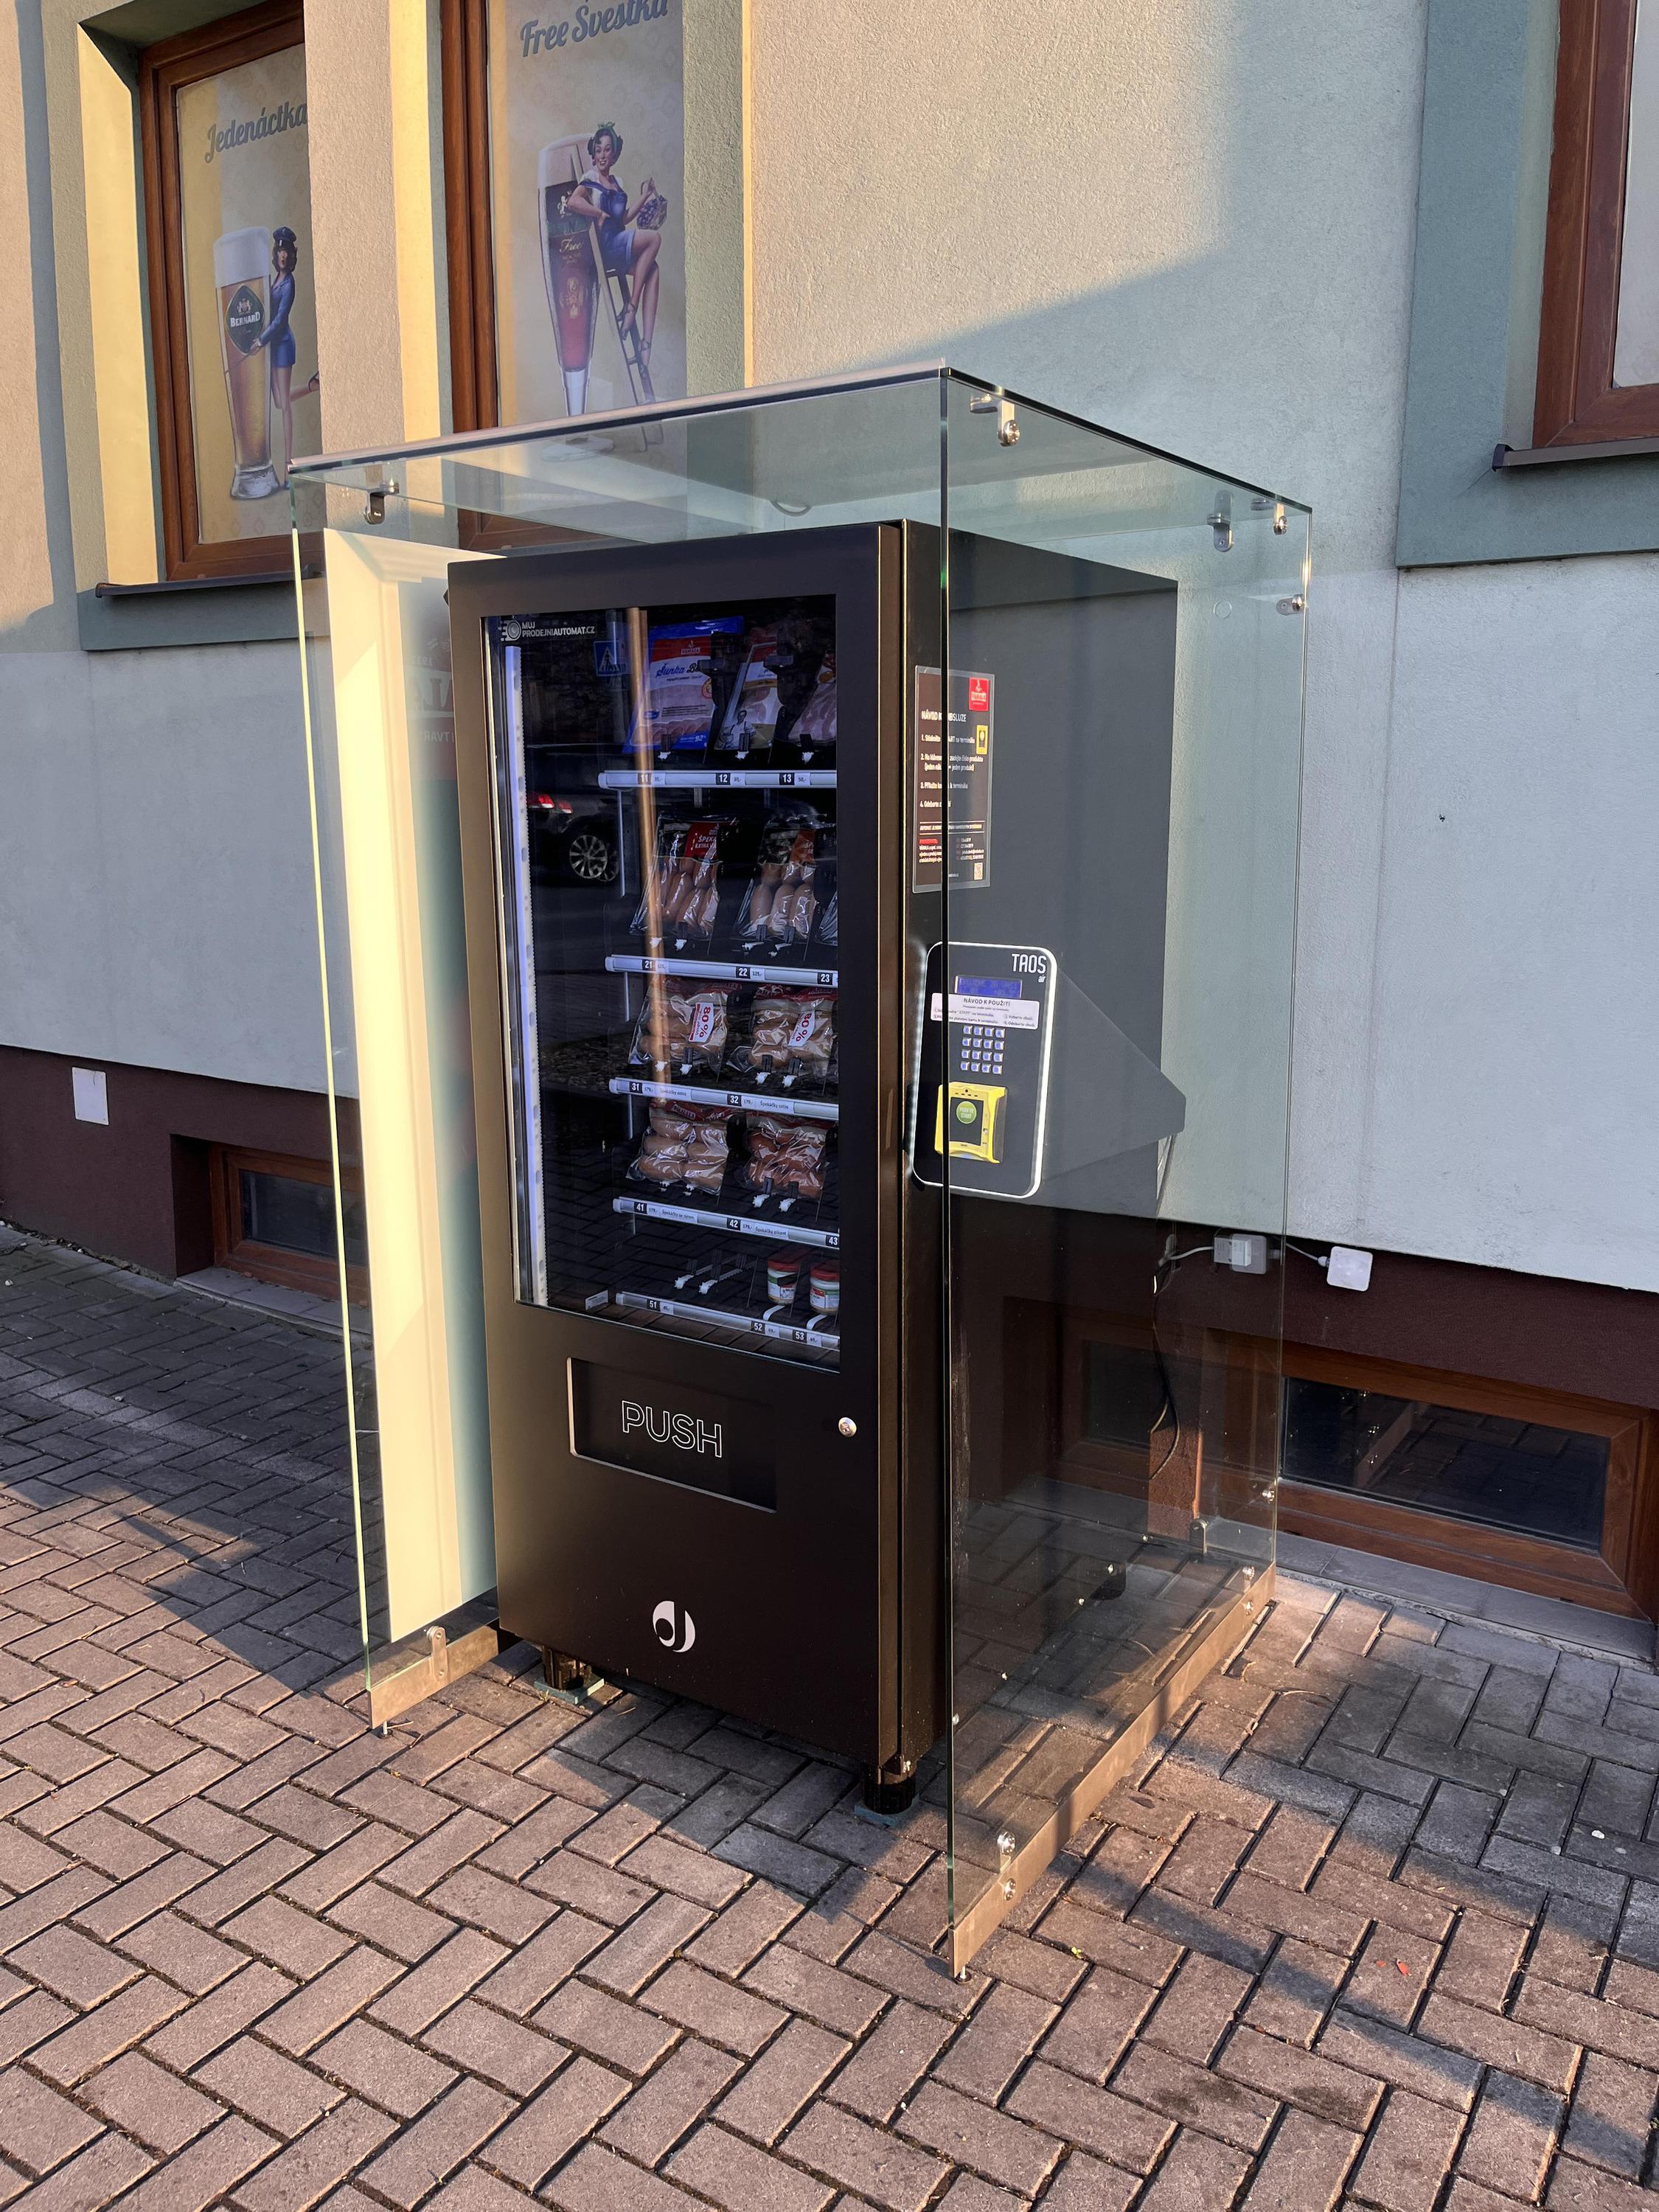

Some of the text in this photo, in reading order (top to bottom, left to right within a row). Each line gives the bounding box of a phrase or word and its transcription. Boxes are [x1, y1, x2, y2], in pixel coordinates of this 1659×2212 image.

[520, 20, 569, 58] Free
[204, 101, 307, 164] Jedenáctka
[230, 311, 260, 327] BERNARD
[922, 709, 938, 720] NÁVOD
[948, 712, 967, 722] BSLUZE
[640, 773, 648, 782] 11
[719, 773, 728, 783] 12
[783, 773, 792, 783] 13
[644, 960, 653, 969] 21
[1012, 953, 1047, 974] TAOS
[739, 967, 748, 977] 22
[821, 973, 830, 983] 23
[1037, 974, 1046, 983] air
[632, 1083, 639, 1091] 31
[730, 1096, 739, 1104] 32
[636, 1203, 644, 1211] 41
[729, 1220, 738, 1228] 42
[828, 1237, 838, 1245] 43
[650, 1300, 657, 1309] 51
[754, 1323, 762, 1332] 52
[796, 1332, 804, 1340] 53
[622, 1400, 722, 1458] PUSH
